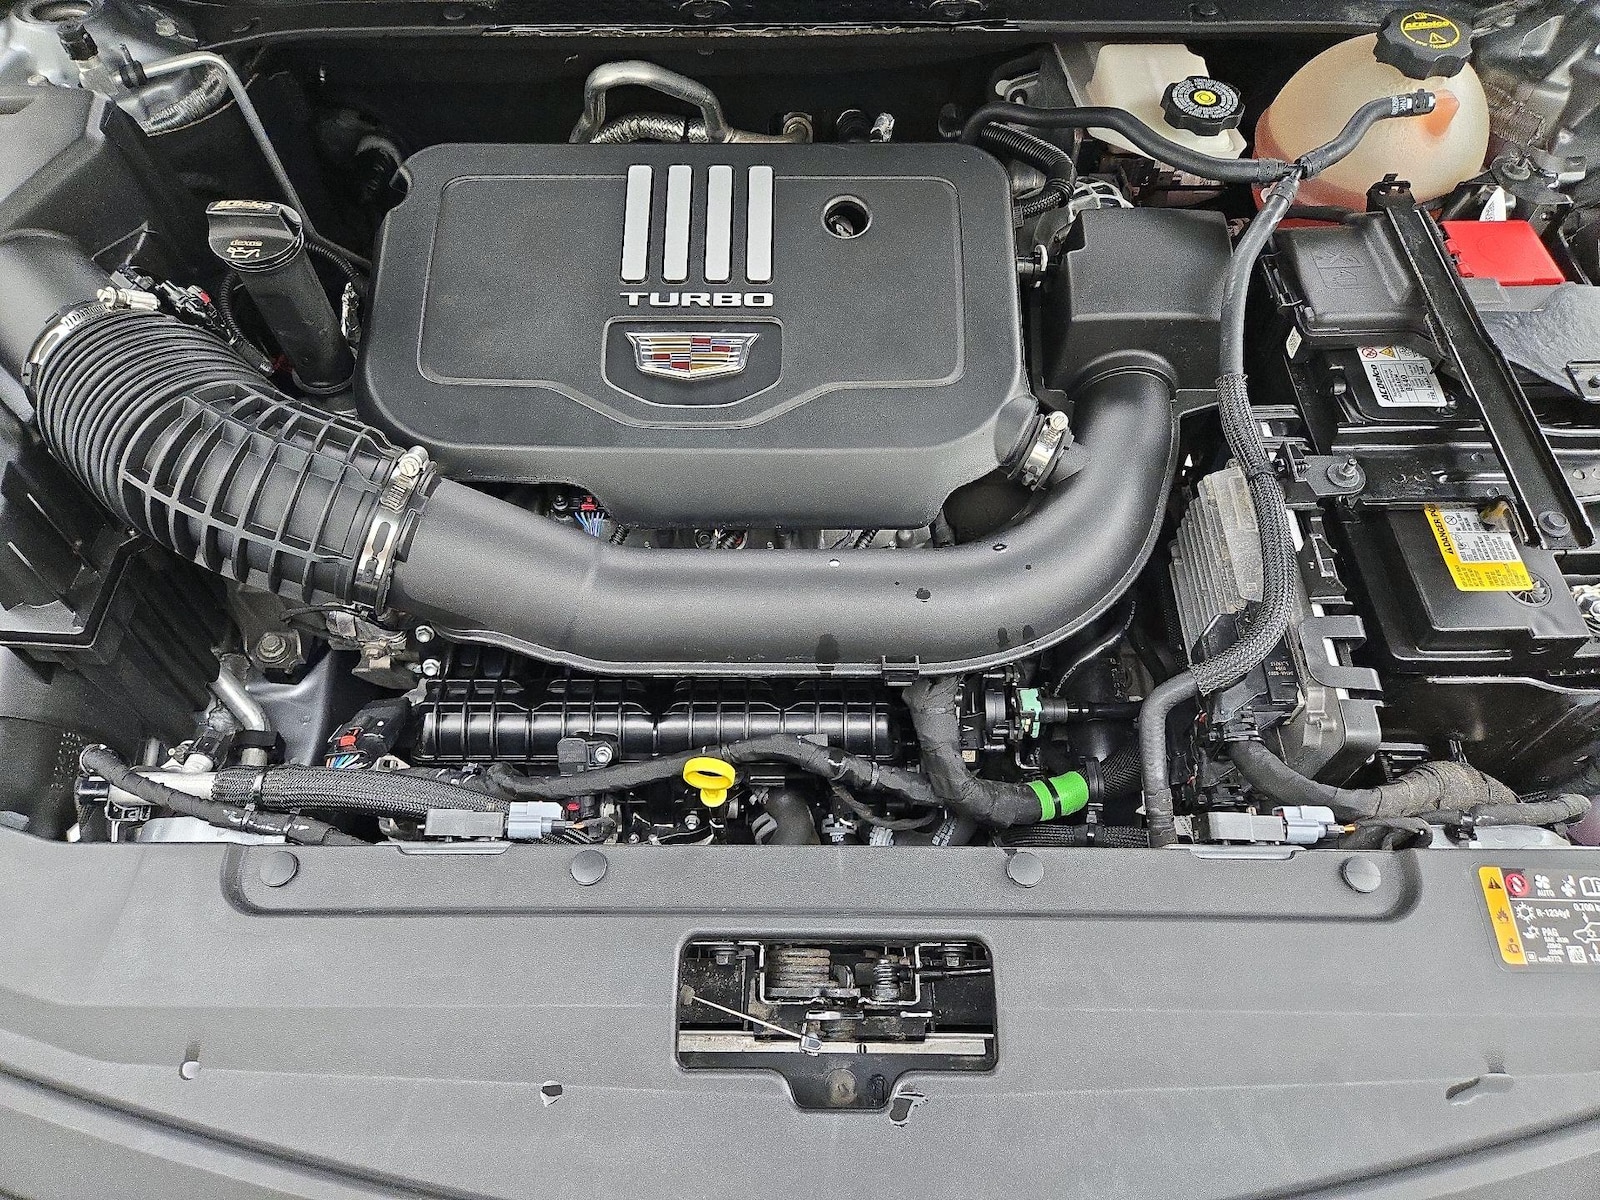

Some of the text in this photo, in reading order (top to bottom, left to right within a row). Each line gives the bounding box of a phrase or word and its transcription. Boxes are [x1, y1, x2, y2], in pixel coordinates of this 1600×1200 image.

[619, 292, 774, 307] TURBO
[1537, 889, 1555, 897] AUTO
[1541, 928, 1559, 937] PAG
